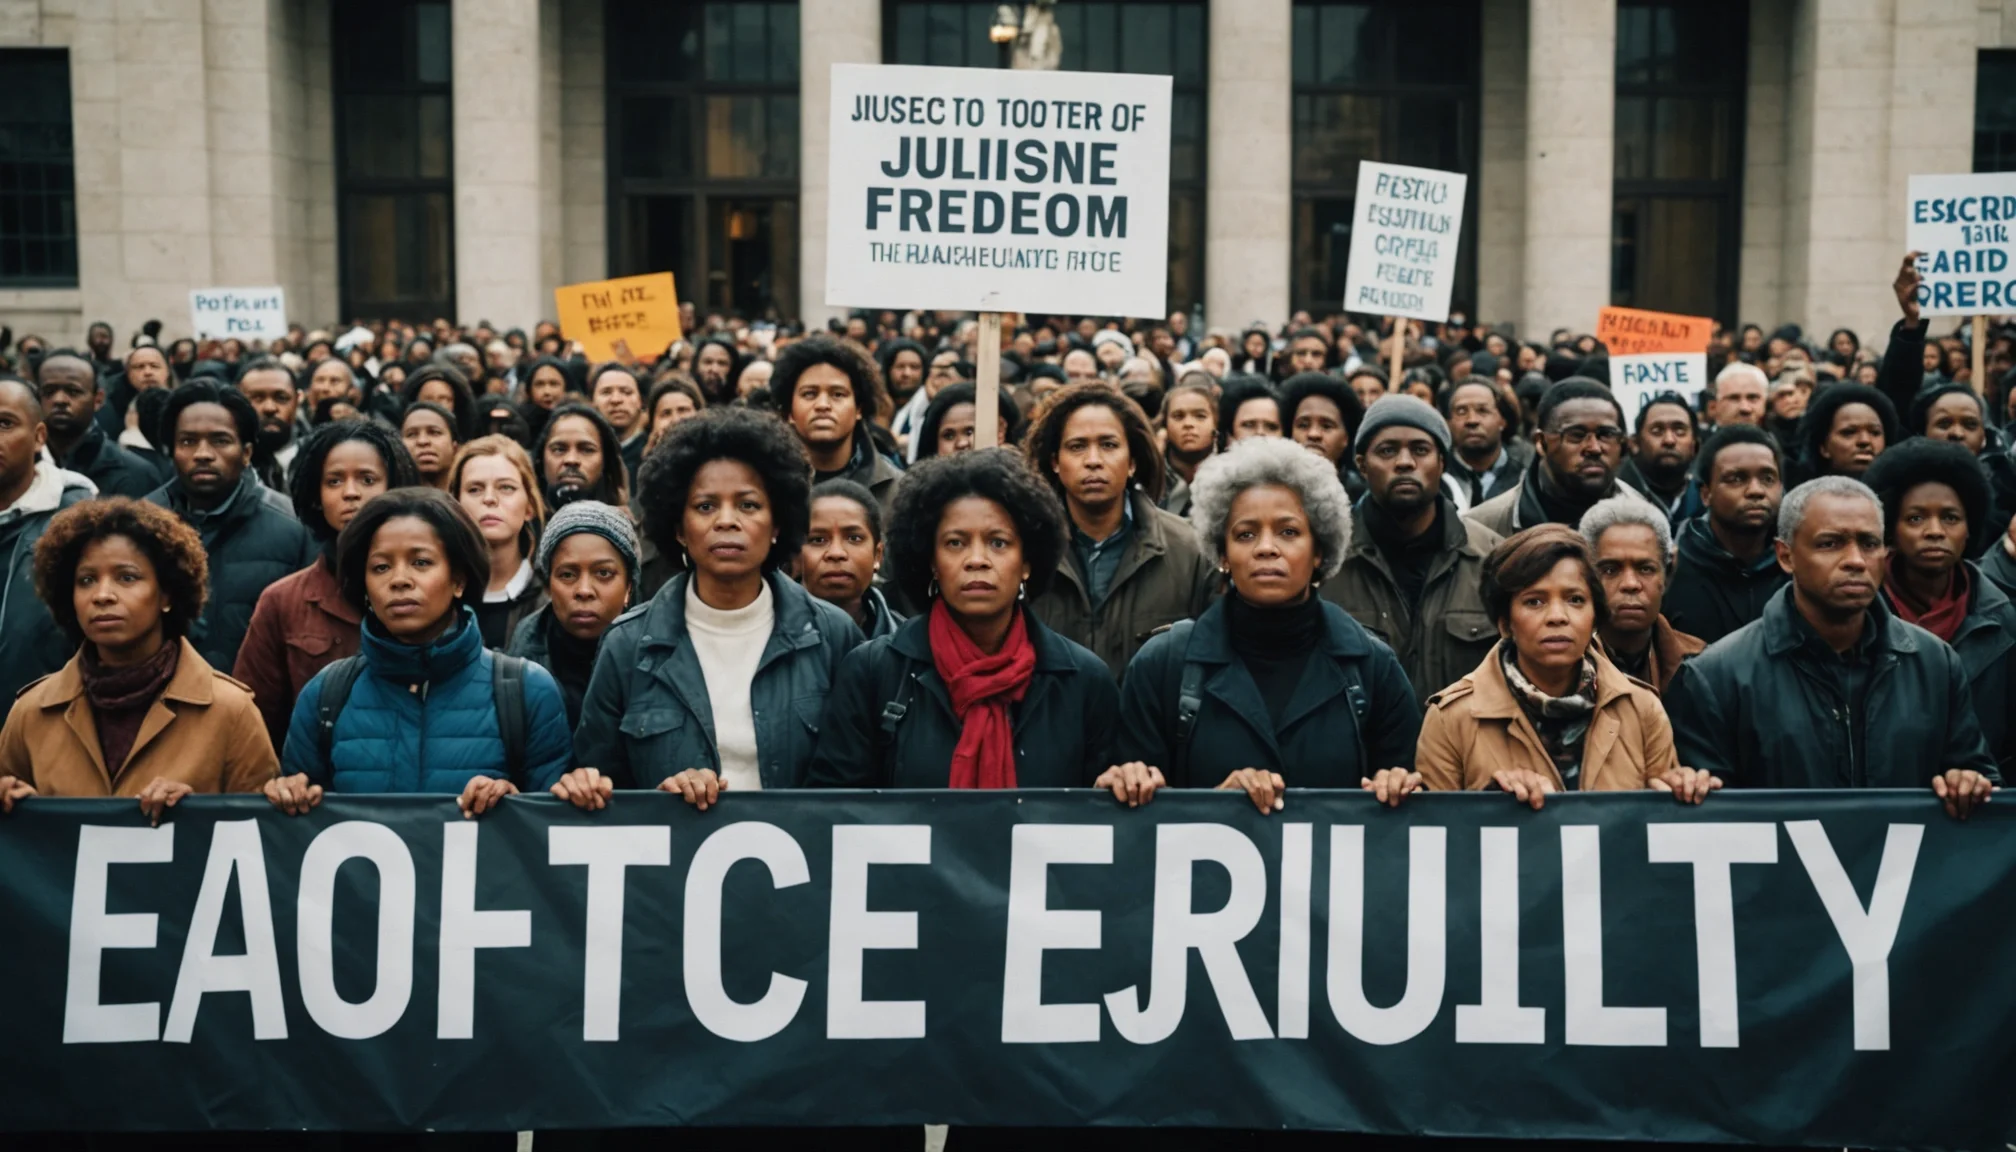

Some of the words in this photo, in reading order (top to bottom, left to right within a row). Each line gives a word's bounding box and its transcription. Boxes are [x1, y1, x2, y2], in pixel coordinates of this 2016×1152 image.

[952, 98, 984, 127] TO
[1111, 103, 1147, 132] OF
[881, 136, 1118, 185] JULIISNE
[866, 187, 1128, 238] FREDEOM
